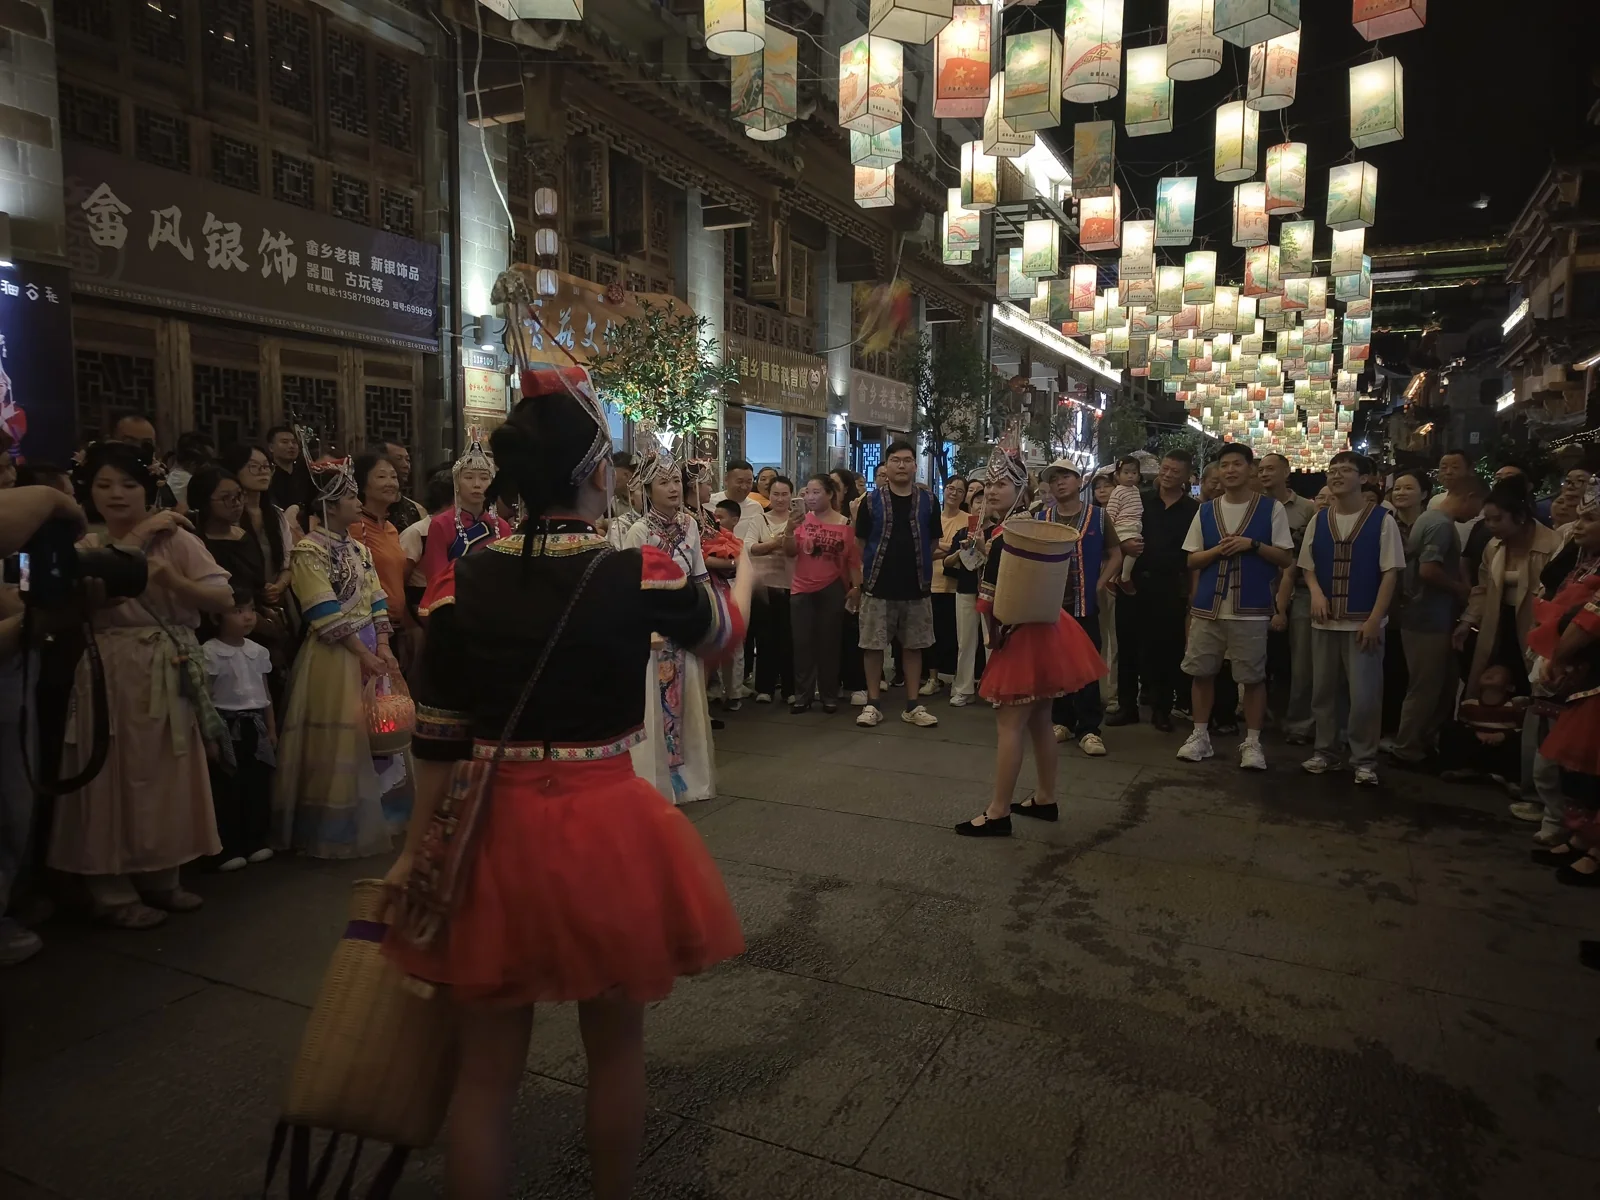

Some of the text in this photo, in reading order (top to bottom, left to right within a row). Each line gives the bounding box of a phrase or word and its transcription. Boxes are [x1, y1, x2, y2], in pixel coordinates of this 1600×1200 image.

[82, 182, 298, 284] 畲风银饰
[306, 239, 420, 281] 畲乡老银 新银饰品
[306, 262, 384, 293] 器皿 古玩等
[392, 301, 433, 317] 短号:699829
